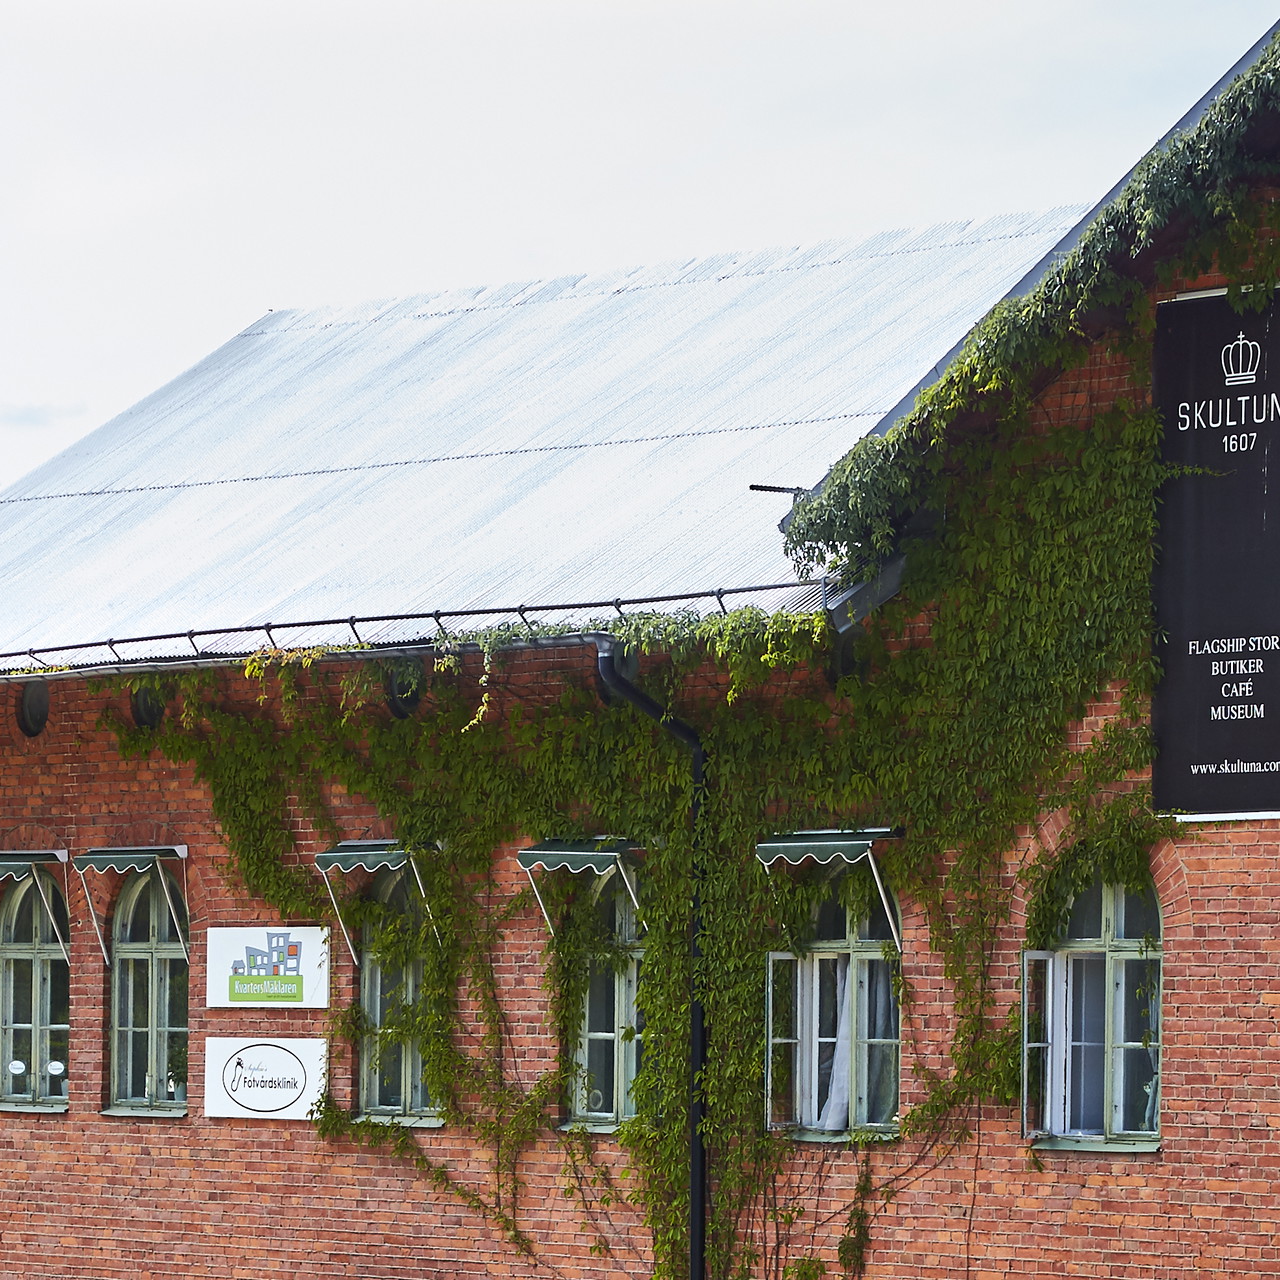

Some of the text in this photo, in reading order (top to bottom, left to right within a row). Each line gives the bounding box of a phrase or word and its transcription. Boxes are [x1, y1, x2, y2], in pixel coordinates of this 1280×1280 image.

[1222, 432, 1257, 453] 1607
[1188, 637, 1247, 655] FLAGSHIP
[1211, 659, 1264, 676] BUTIKER
[1221, 678, 1254, 698] CAFÉ
[1210, 703, 1265, 720] MUSEUM
[234, 979, 297, 994] KvartersMäklaren
[243, 1075, 298, 1090] Fotvårdsklinik
